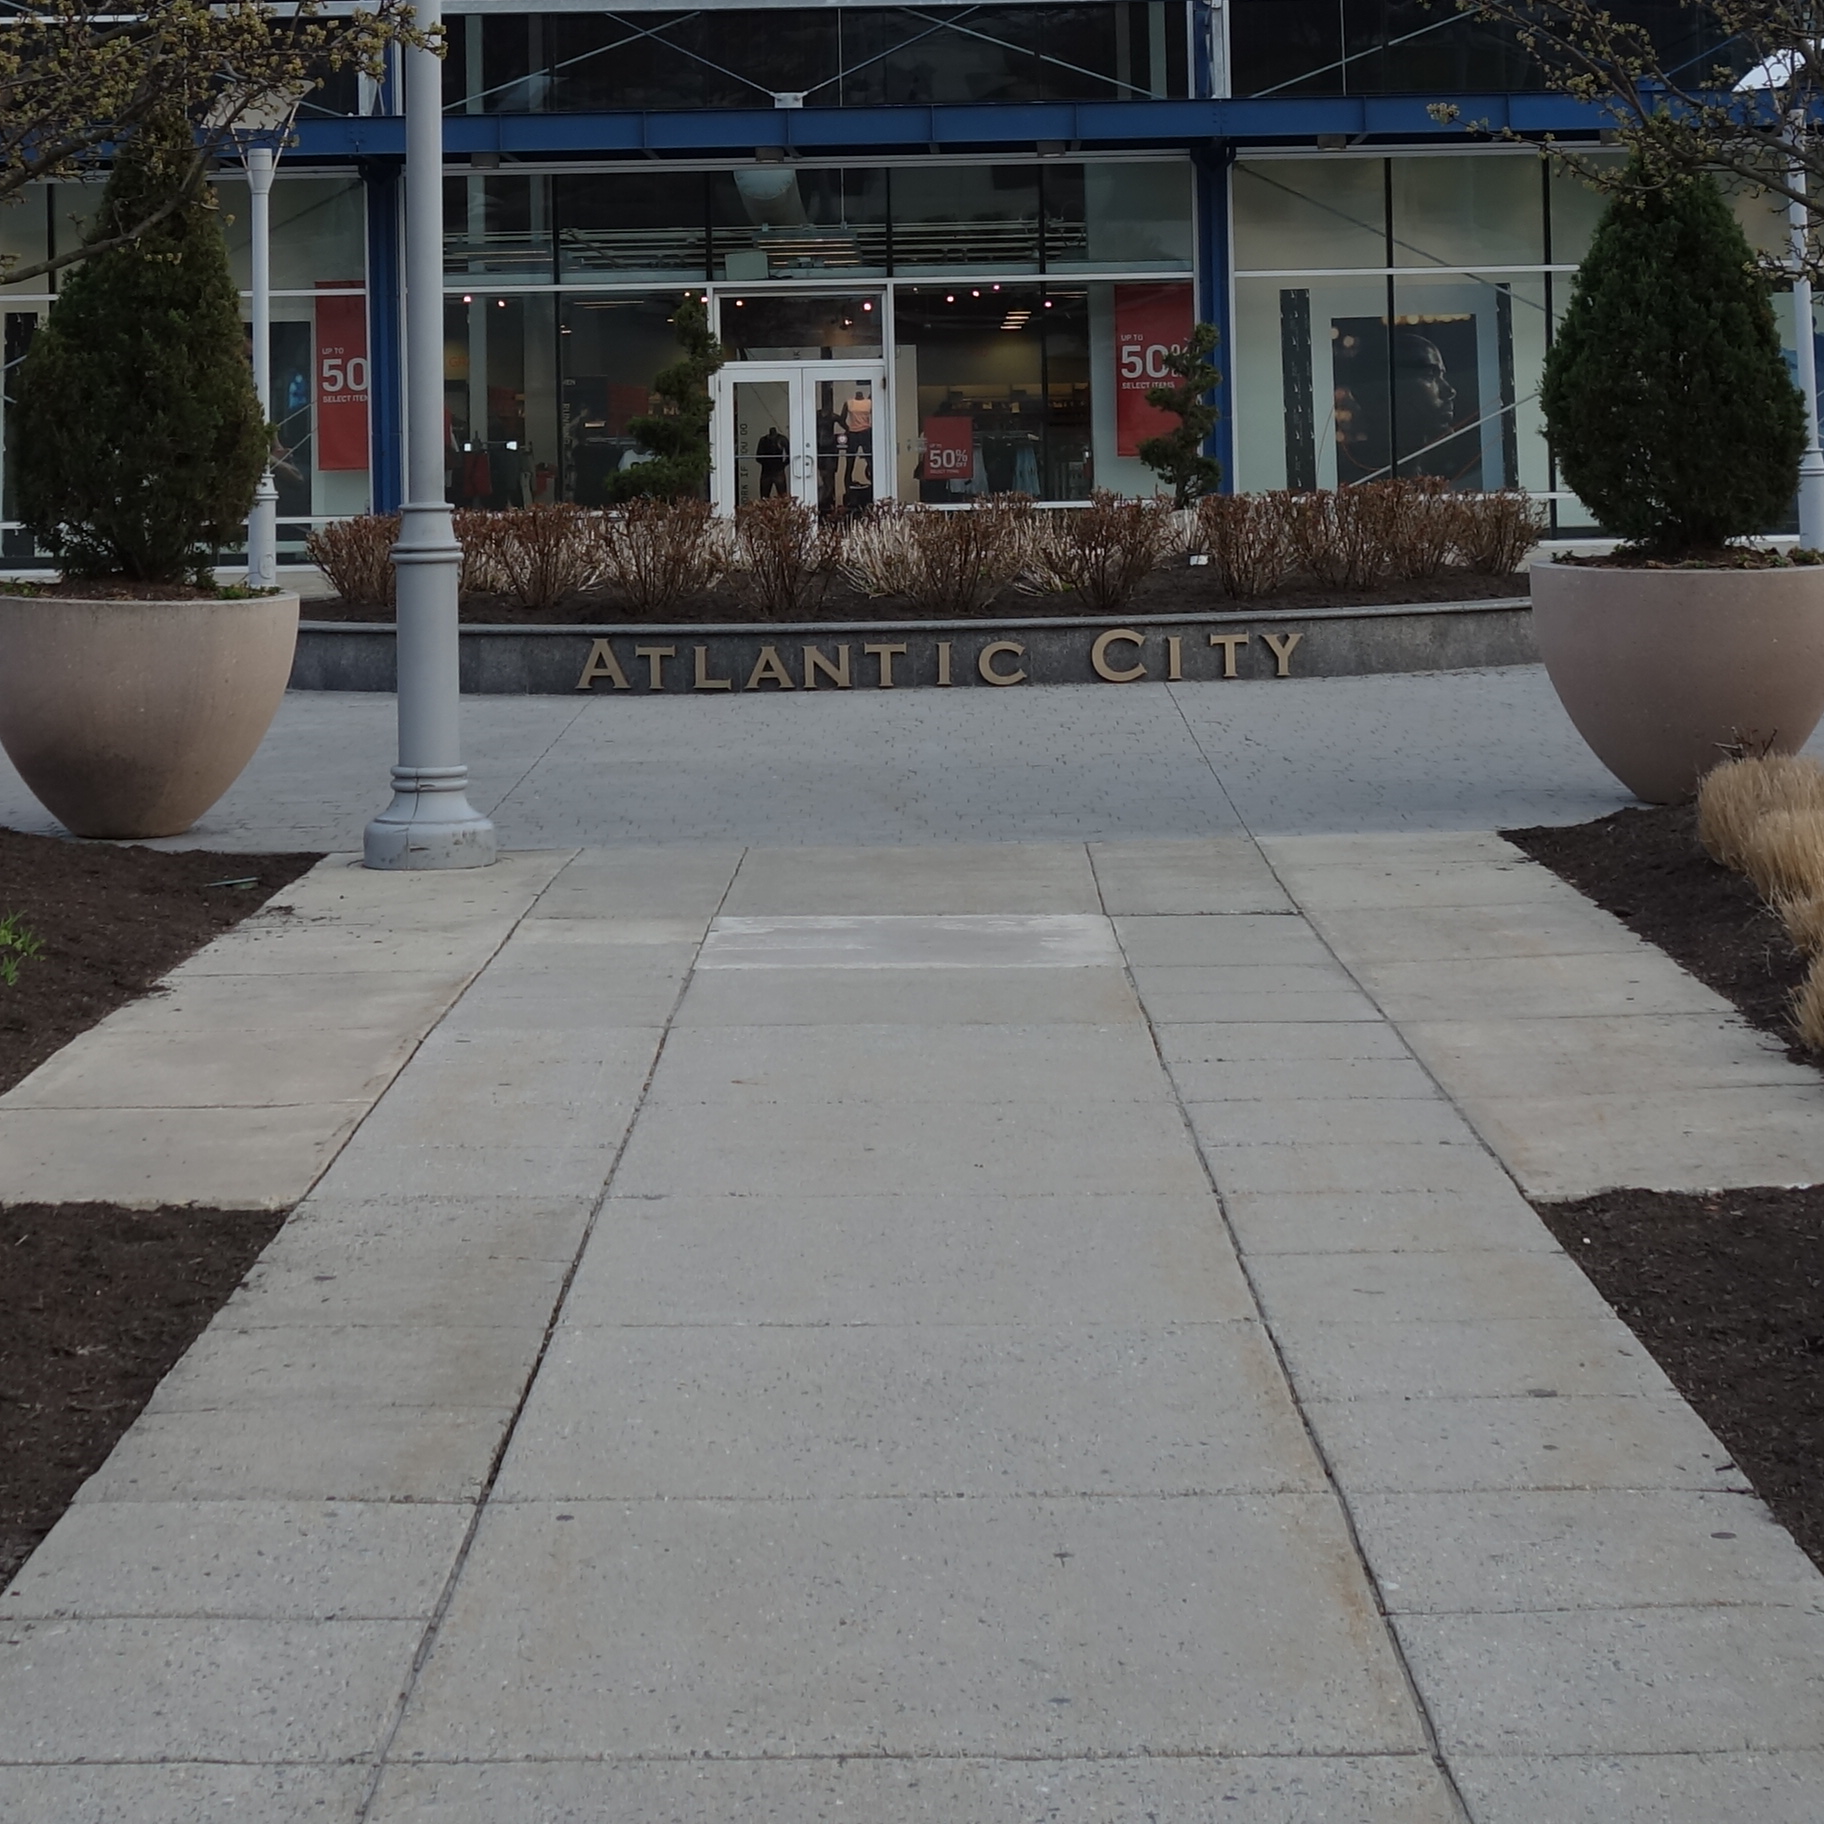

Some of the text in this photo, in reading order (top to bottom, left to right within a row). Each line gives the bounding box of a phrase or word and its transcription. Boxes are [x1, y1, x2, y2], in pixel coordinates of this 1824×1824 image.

[322, 347, 345, 355] UP TO
[322, 357, 369, 392] 50
[1122, 381, 1175, 389] SELECT ITEMS
[323, 394, 368, 403] SELECT ITEM
[929, 449, 968, 469] 50%
[576, 628, 1304, 690] ATLANTIC CITY
